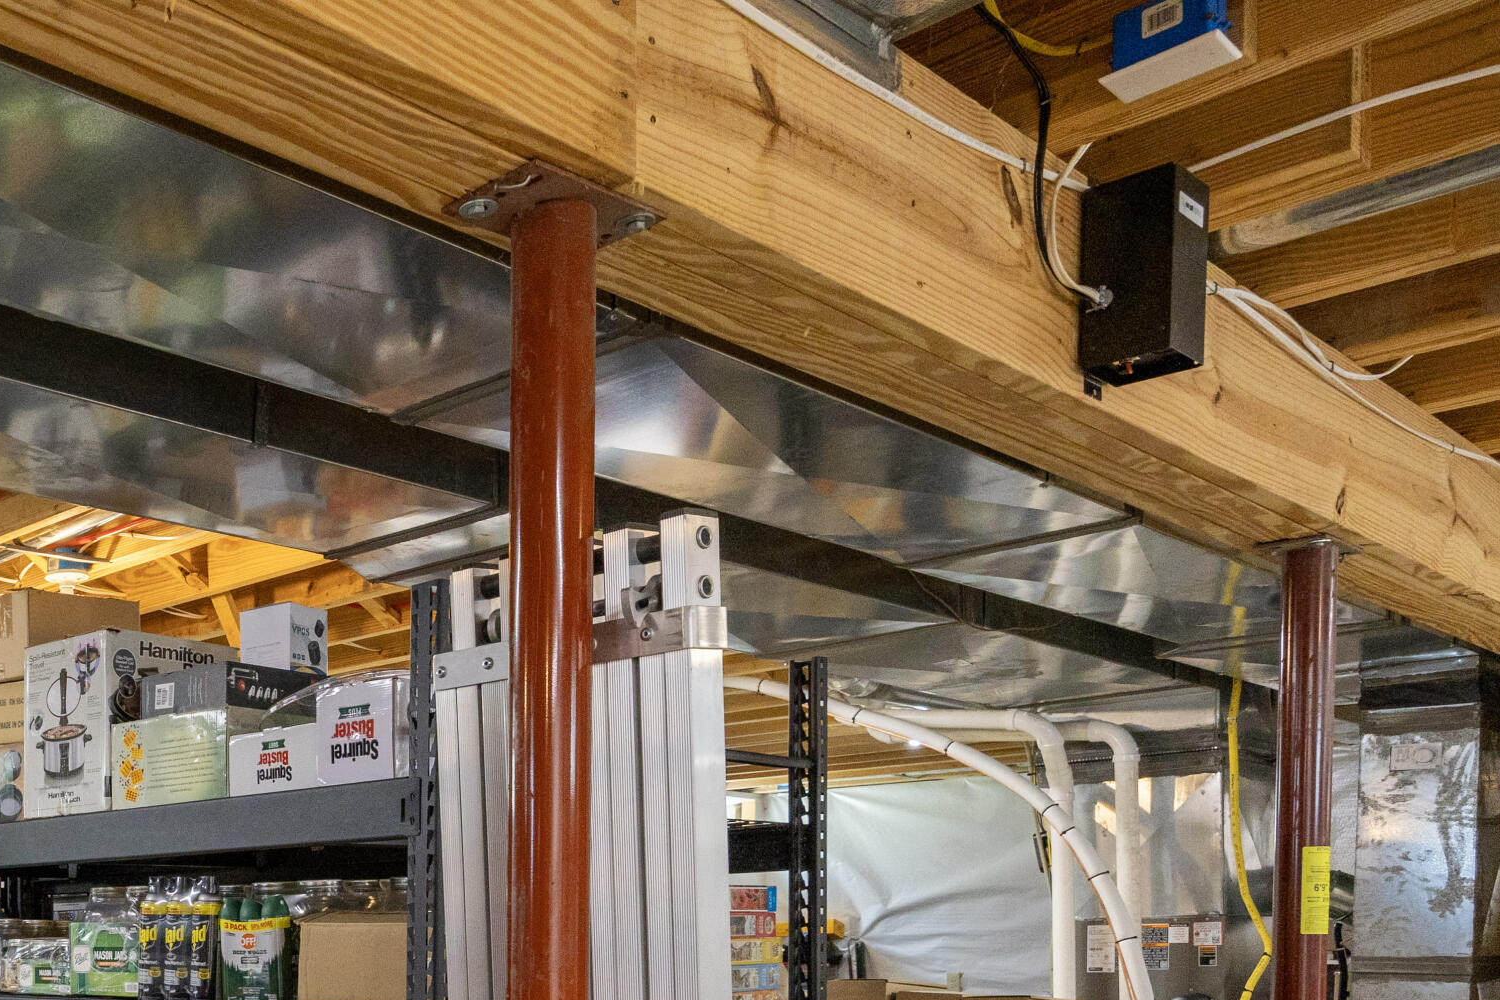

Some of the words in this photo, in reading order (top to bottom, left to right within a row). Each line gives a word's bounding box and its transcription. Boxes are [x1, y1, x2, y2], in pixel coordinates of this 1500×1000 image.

[140, 641, 215, 664] Hamilton
[333, 719, 374, 740] Buster
[259, 750, 289, 766] Buster
[330, 738, 379, 764] Squirrel
[257, 765, 292, 784] Squirrel
[229, 923, 247, 931] PACK
[94, 950, 113, 960] MASON
[114, 950, 128, 960] JARS
